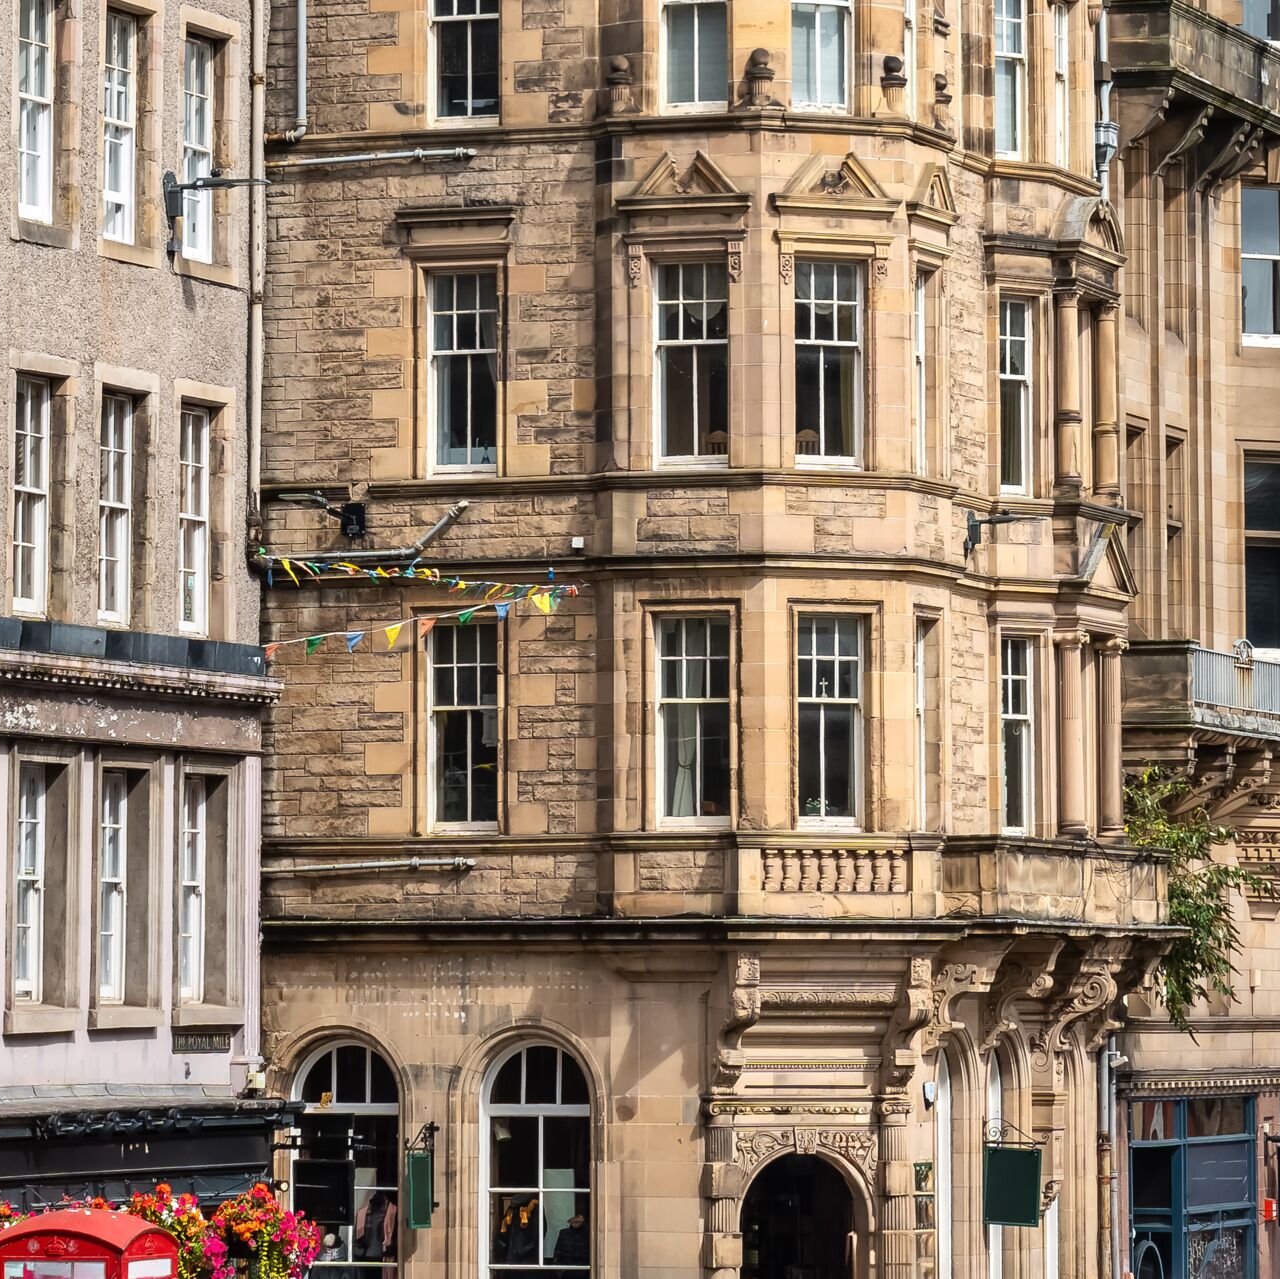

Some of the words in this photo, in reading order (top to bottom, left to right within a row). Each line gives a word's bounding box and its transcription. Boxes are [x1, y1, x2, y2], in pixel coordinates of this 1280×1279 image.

[175, 1035, 186, 1050] THE
[187, 1035, 210, 1050] ROYAL
[212, 1034, 230, 1049] MILE
